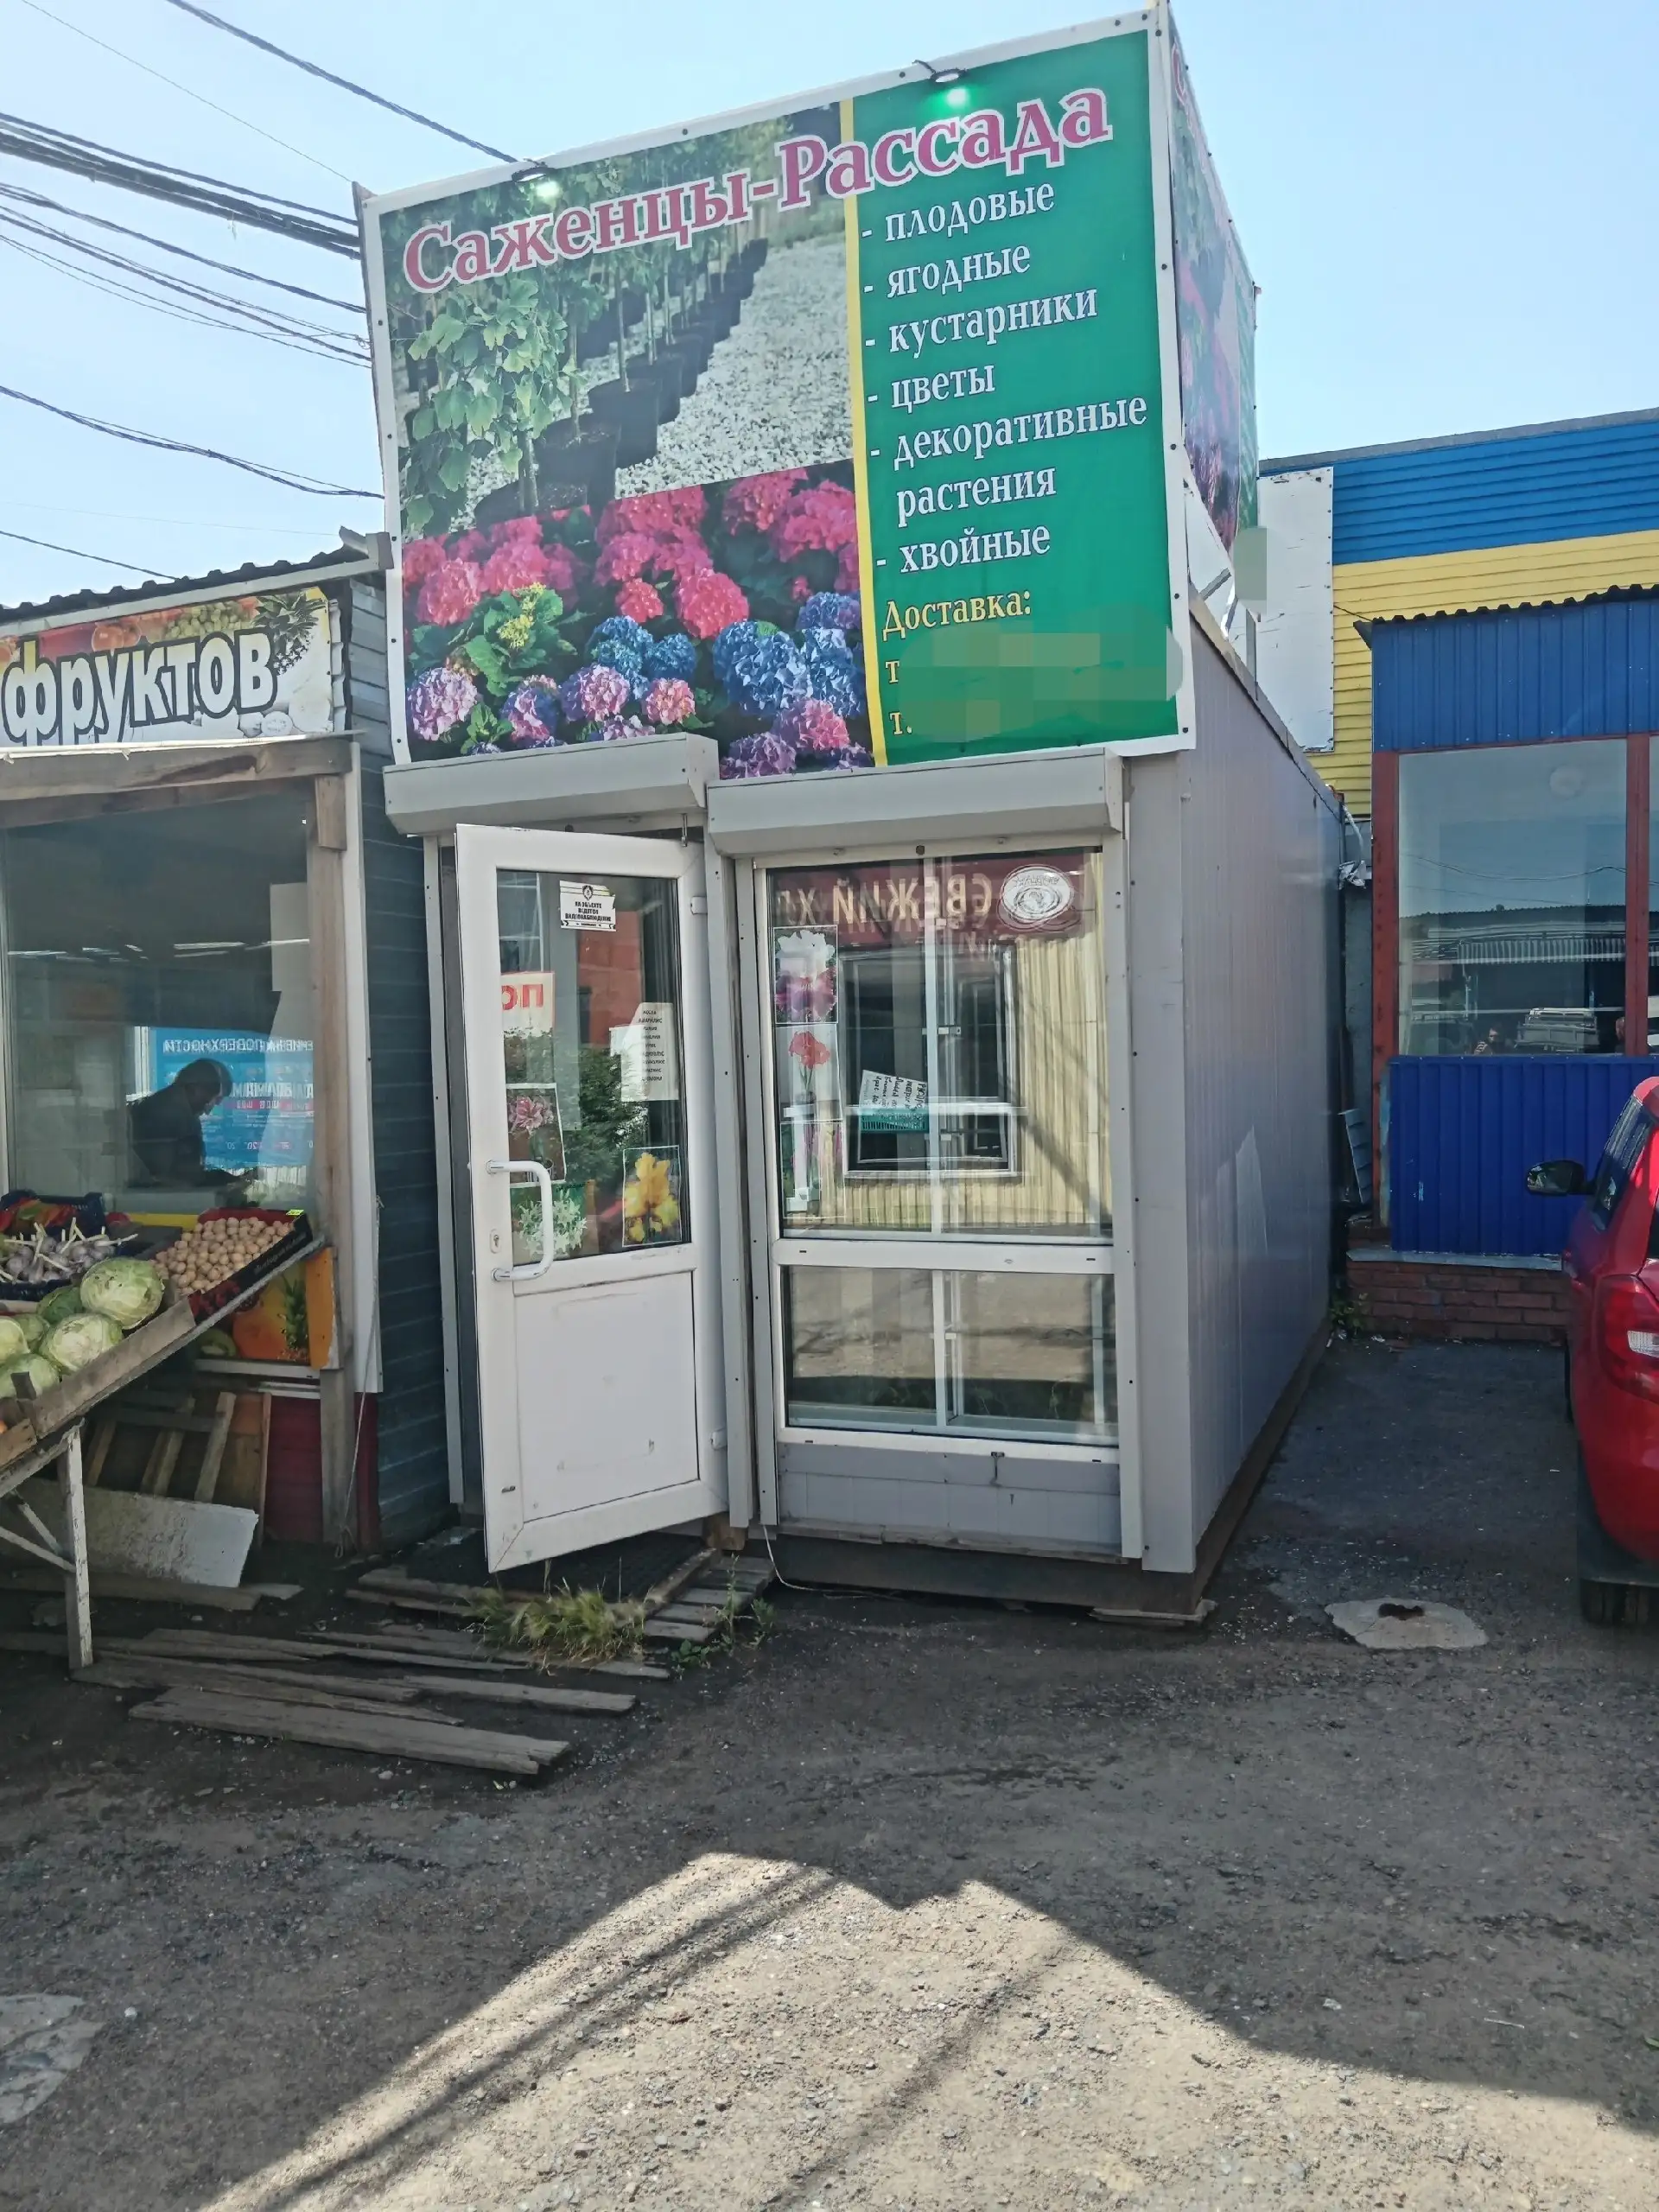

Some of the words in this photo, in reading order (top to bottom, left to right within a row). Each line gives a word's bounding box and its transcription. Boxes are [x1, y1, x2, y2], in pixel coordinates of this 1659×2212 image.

[404, 87, 1114, 294] Саженцы-Рассада
[885, 182, 1055, 243] плодовые
[887, 245, 1032, 299] ягодные
[888, 289, 1098, 359] кустарники
[891, 365, 995, 413] цветы
[893, 396, 1148, 472] декоративные
[896, 467, 1057, 528] растения
[899, 524, 1051, 574] хвойные
[882, 589, 1032, 642] Доставка:
